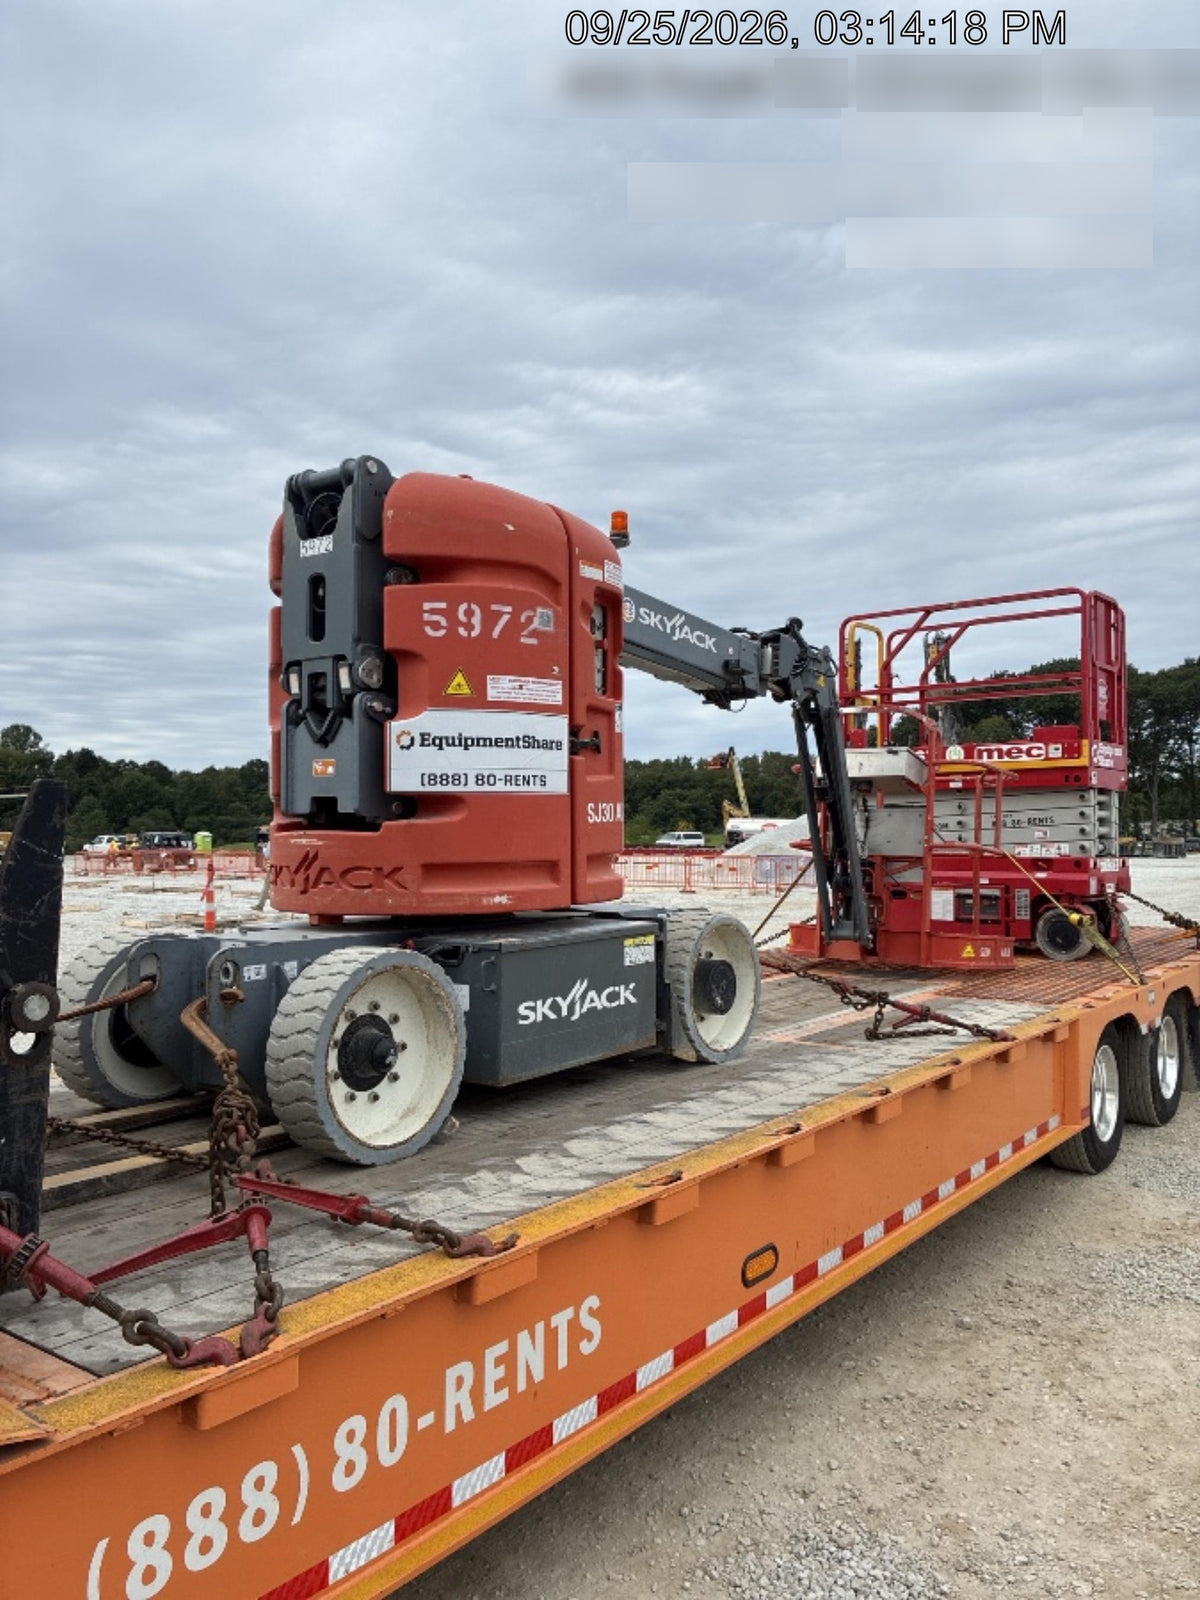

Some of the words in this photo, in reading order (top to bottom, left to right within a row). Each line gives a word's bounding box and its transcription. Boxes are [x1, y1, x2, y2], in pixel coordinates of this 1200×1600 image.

[422, 602, 540, 645] 5972
[637, 606, 717, 653] SKYJACK
[419, 732, 563, 751] EquipmentShare
[474, 773, 547, 787] 80-RENTS
[517, 978, 637, 1025] SKYJACK
[86, 1443, 310, 1600] (888)
[331, 1295, 602, 1493] 80-RENTS
